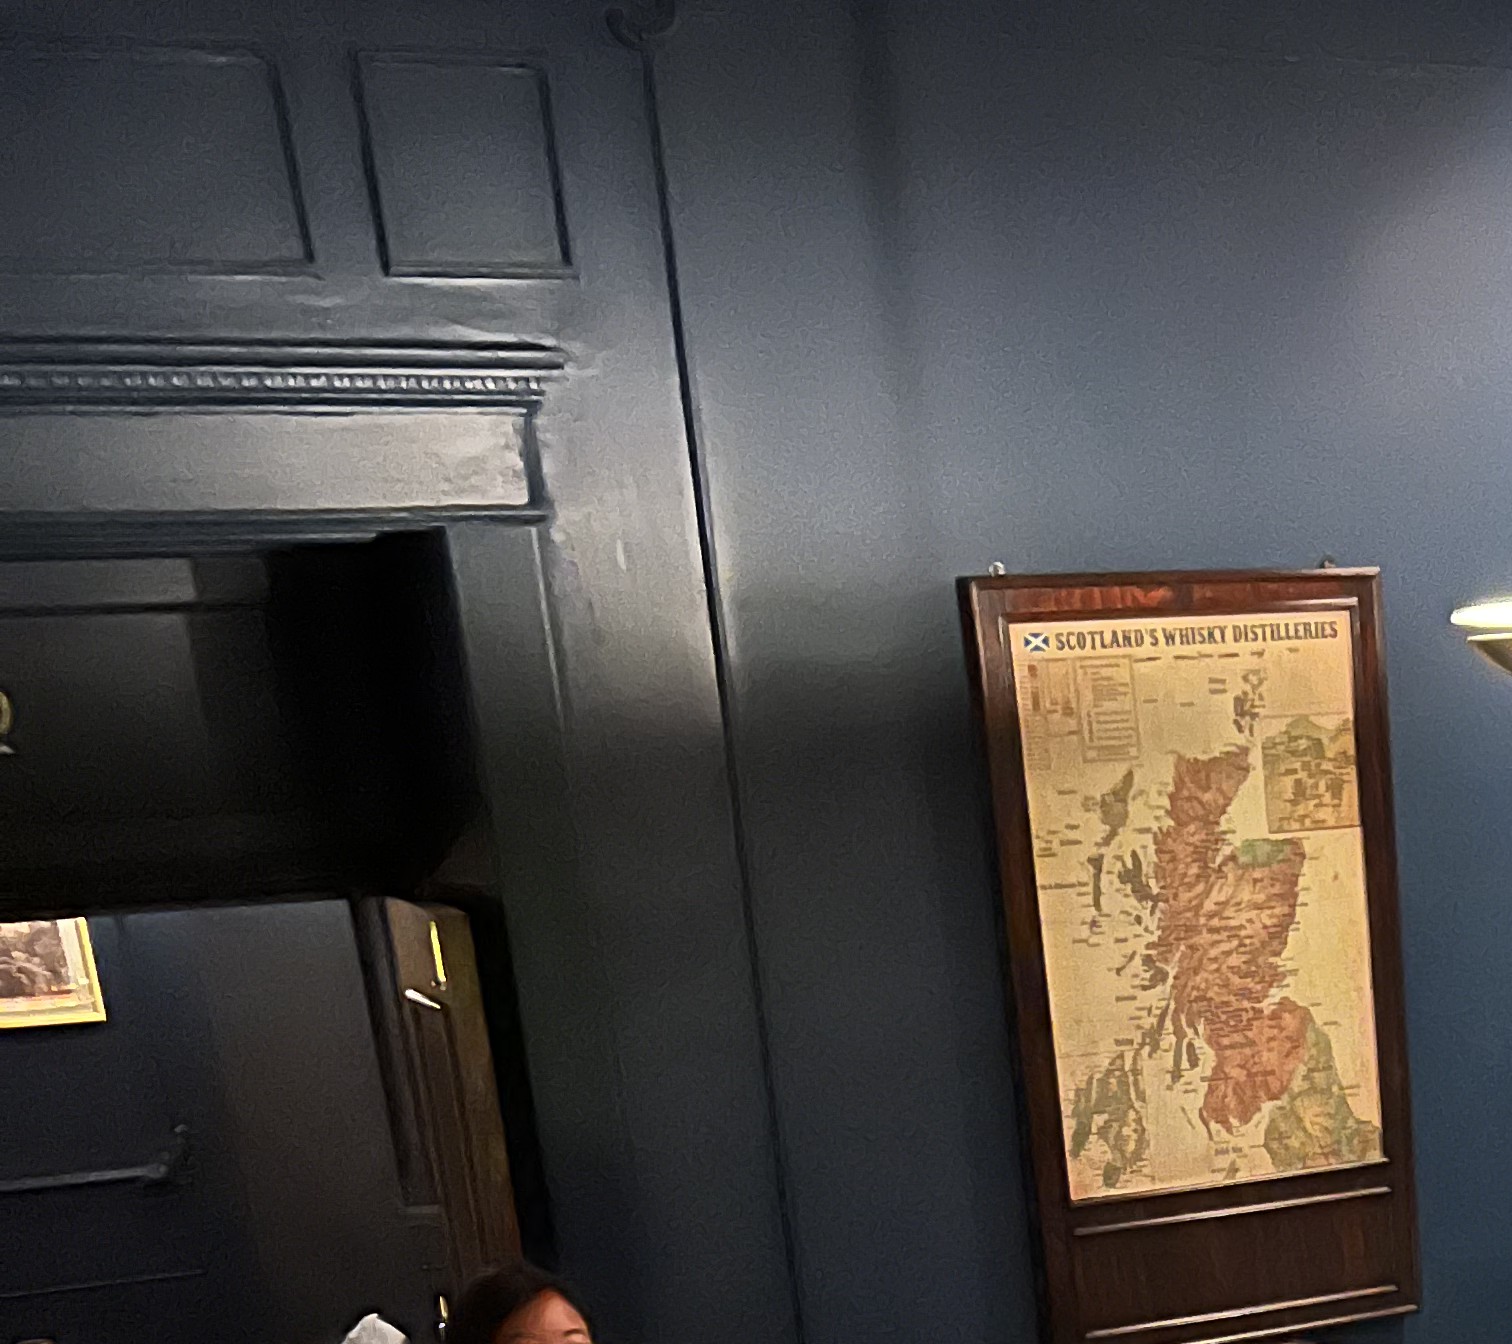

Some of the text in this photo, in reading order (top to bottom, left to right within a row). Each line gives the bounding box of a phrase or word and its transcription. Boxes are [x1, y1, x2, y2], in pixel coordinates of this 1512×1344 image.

[1055, 620, 1338, 652] SCOTLAND'S WHISKY DISTILLERIES
